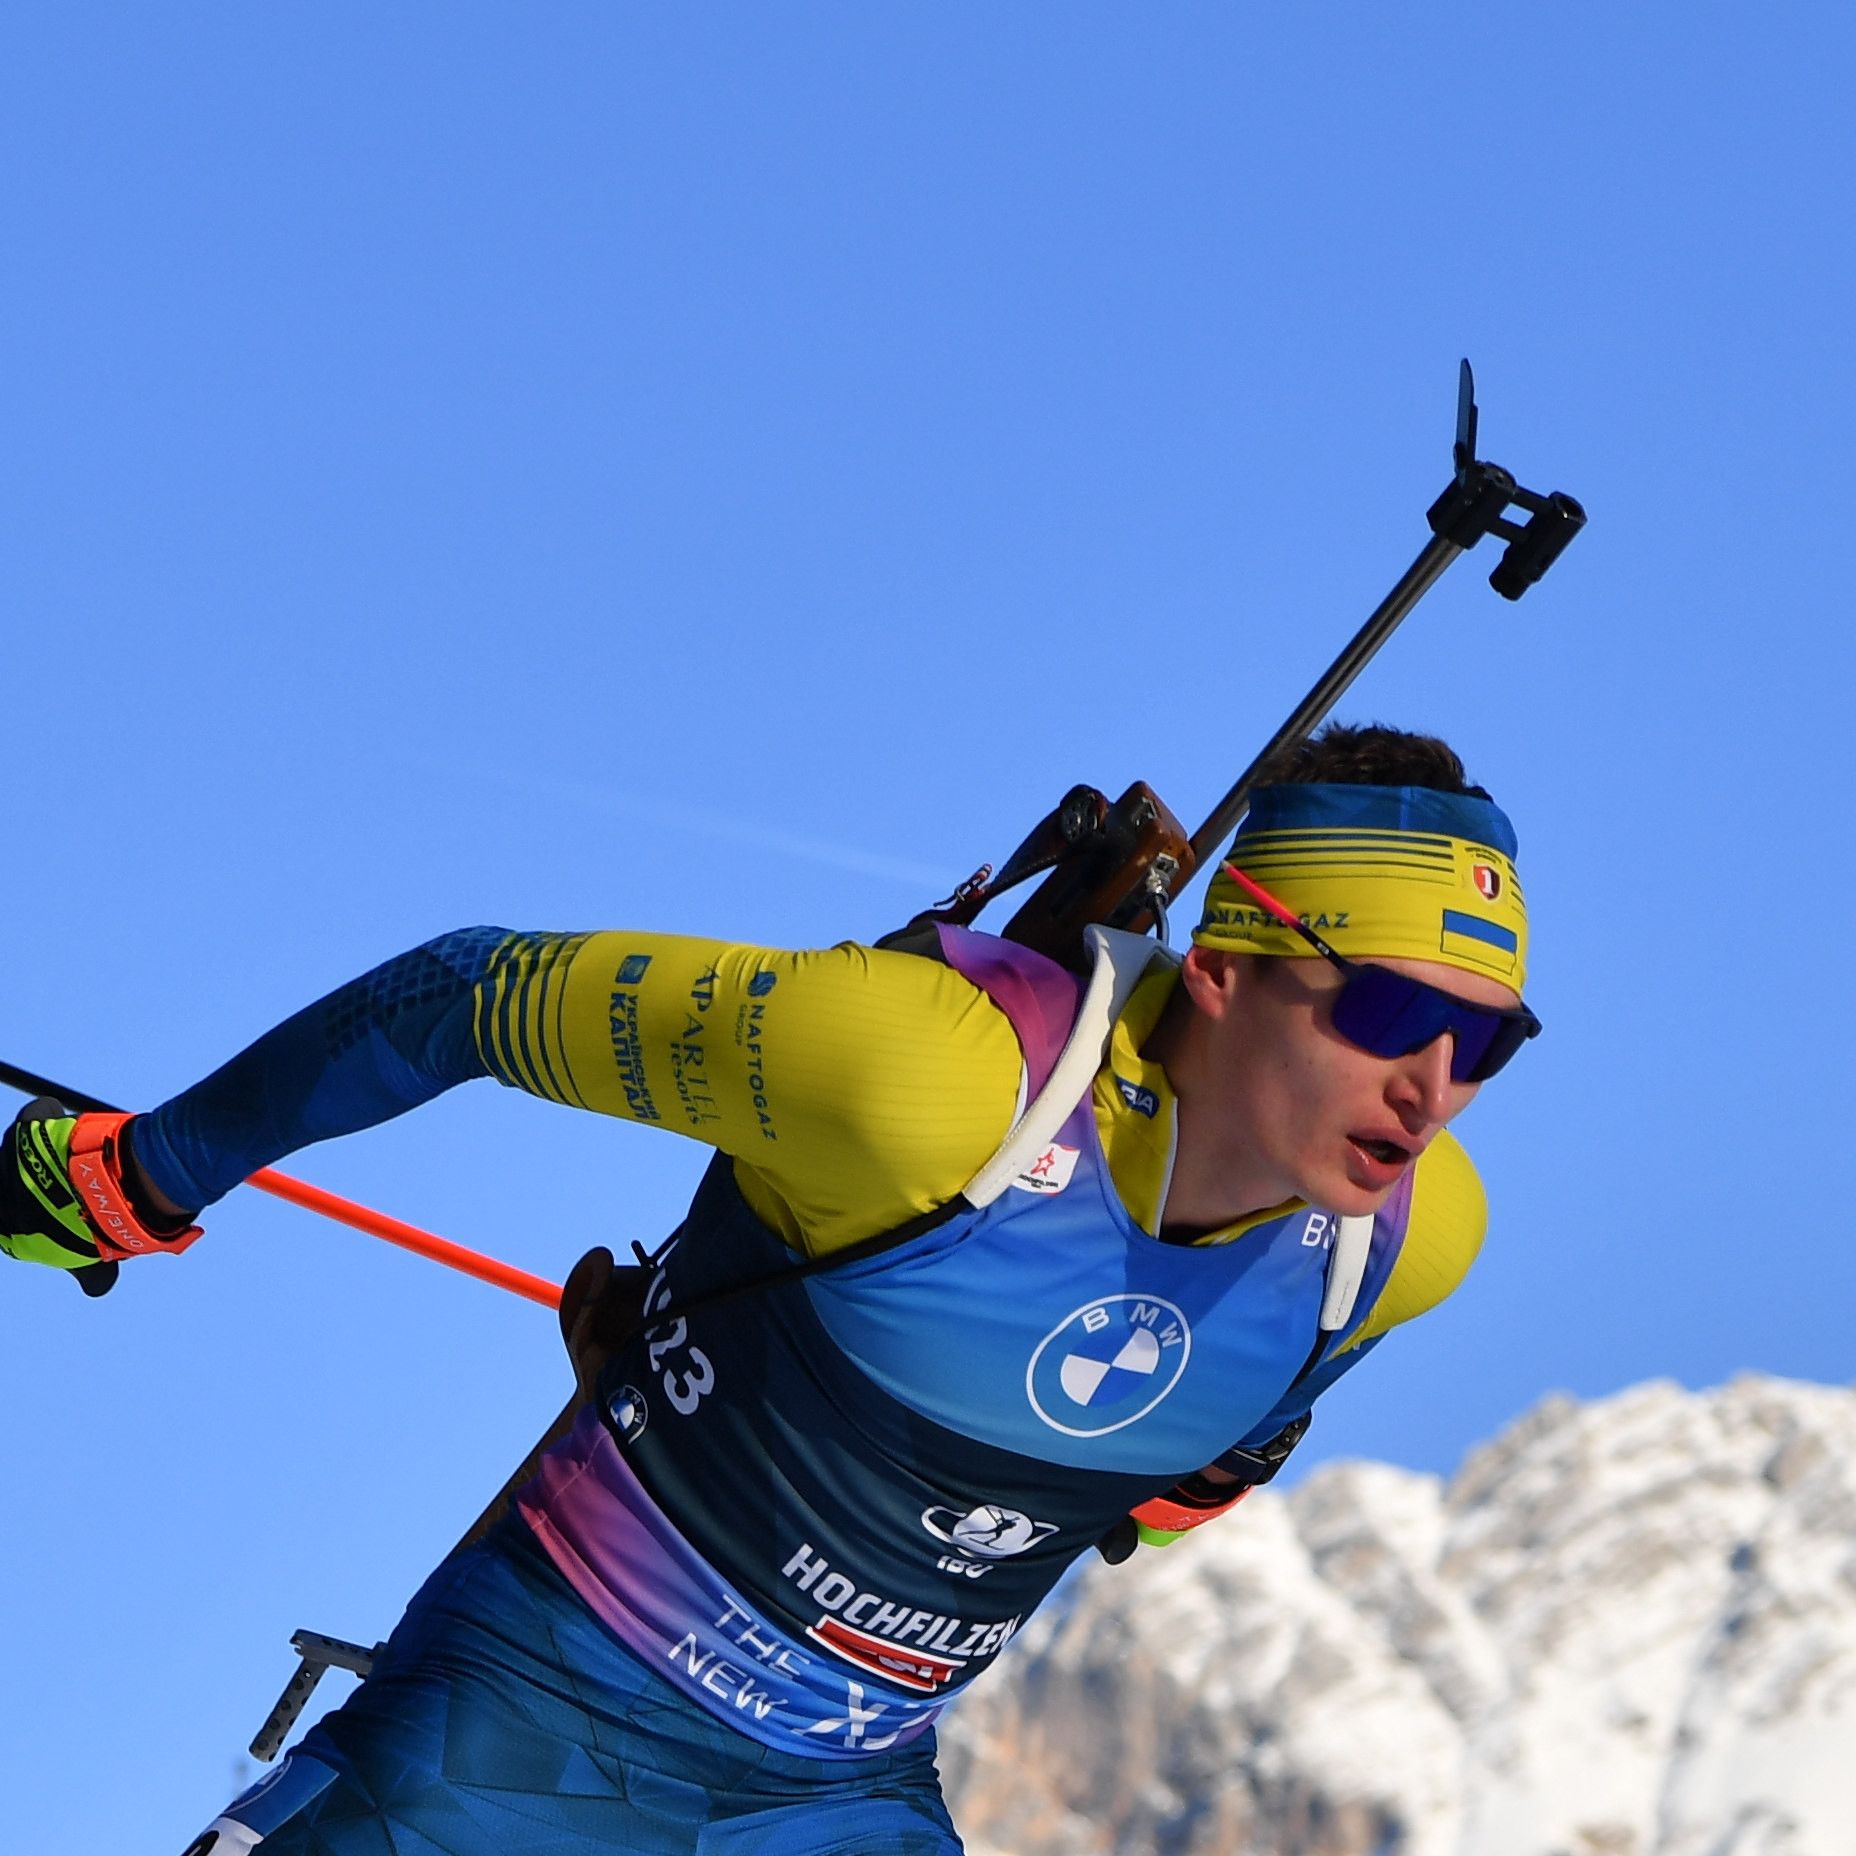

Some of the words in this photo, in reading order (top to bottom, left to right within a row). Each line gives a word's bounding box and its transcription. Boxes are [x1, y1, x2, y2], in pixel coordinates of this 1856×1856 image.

[1220, 910, 1349, 929] NAFTGAZ
[609, 992, 650, 1120] КАПІТАЛ
[746, 1004, 778, 1141] NAFTOGAZ
[1082, 1302, 1182, 1349] BMW
[667, 1632, 789, 1721] NEW
[713, 1593, 810, 1681] THE
